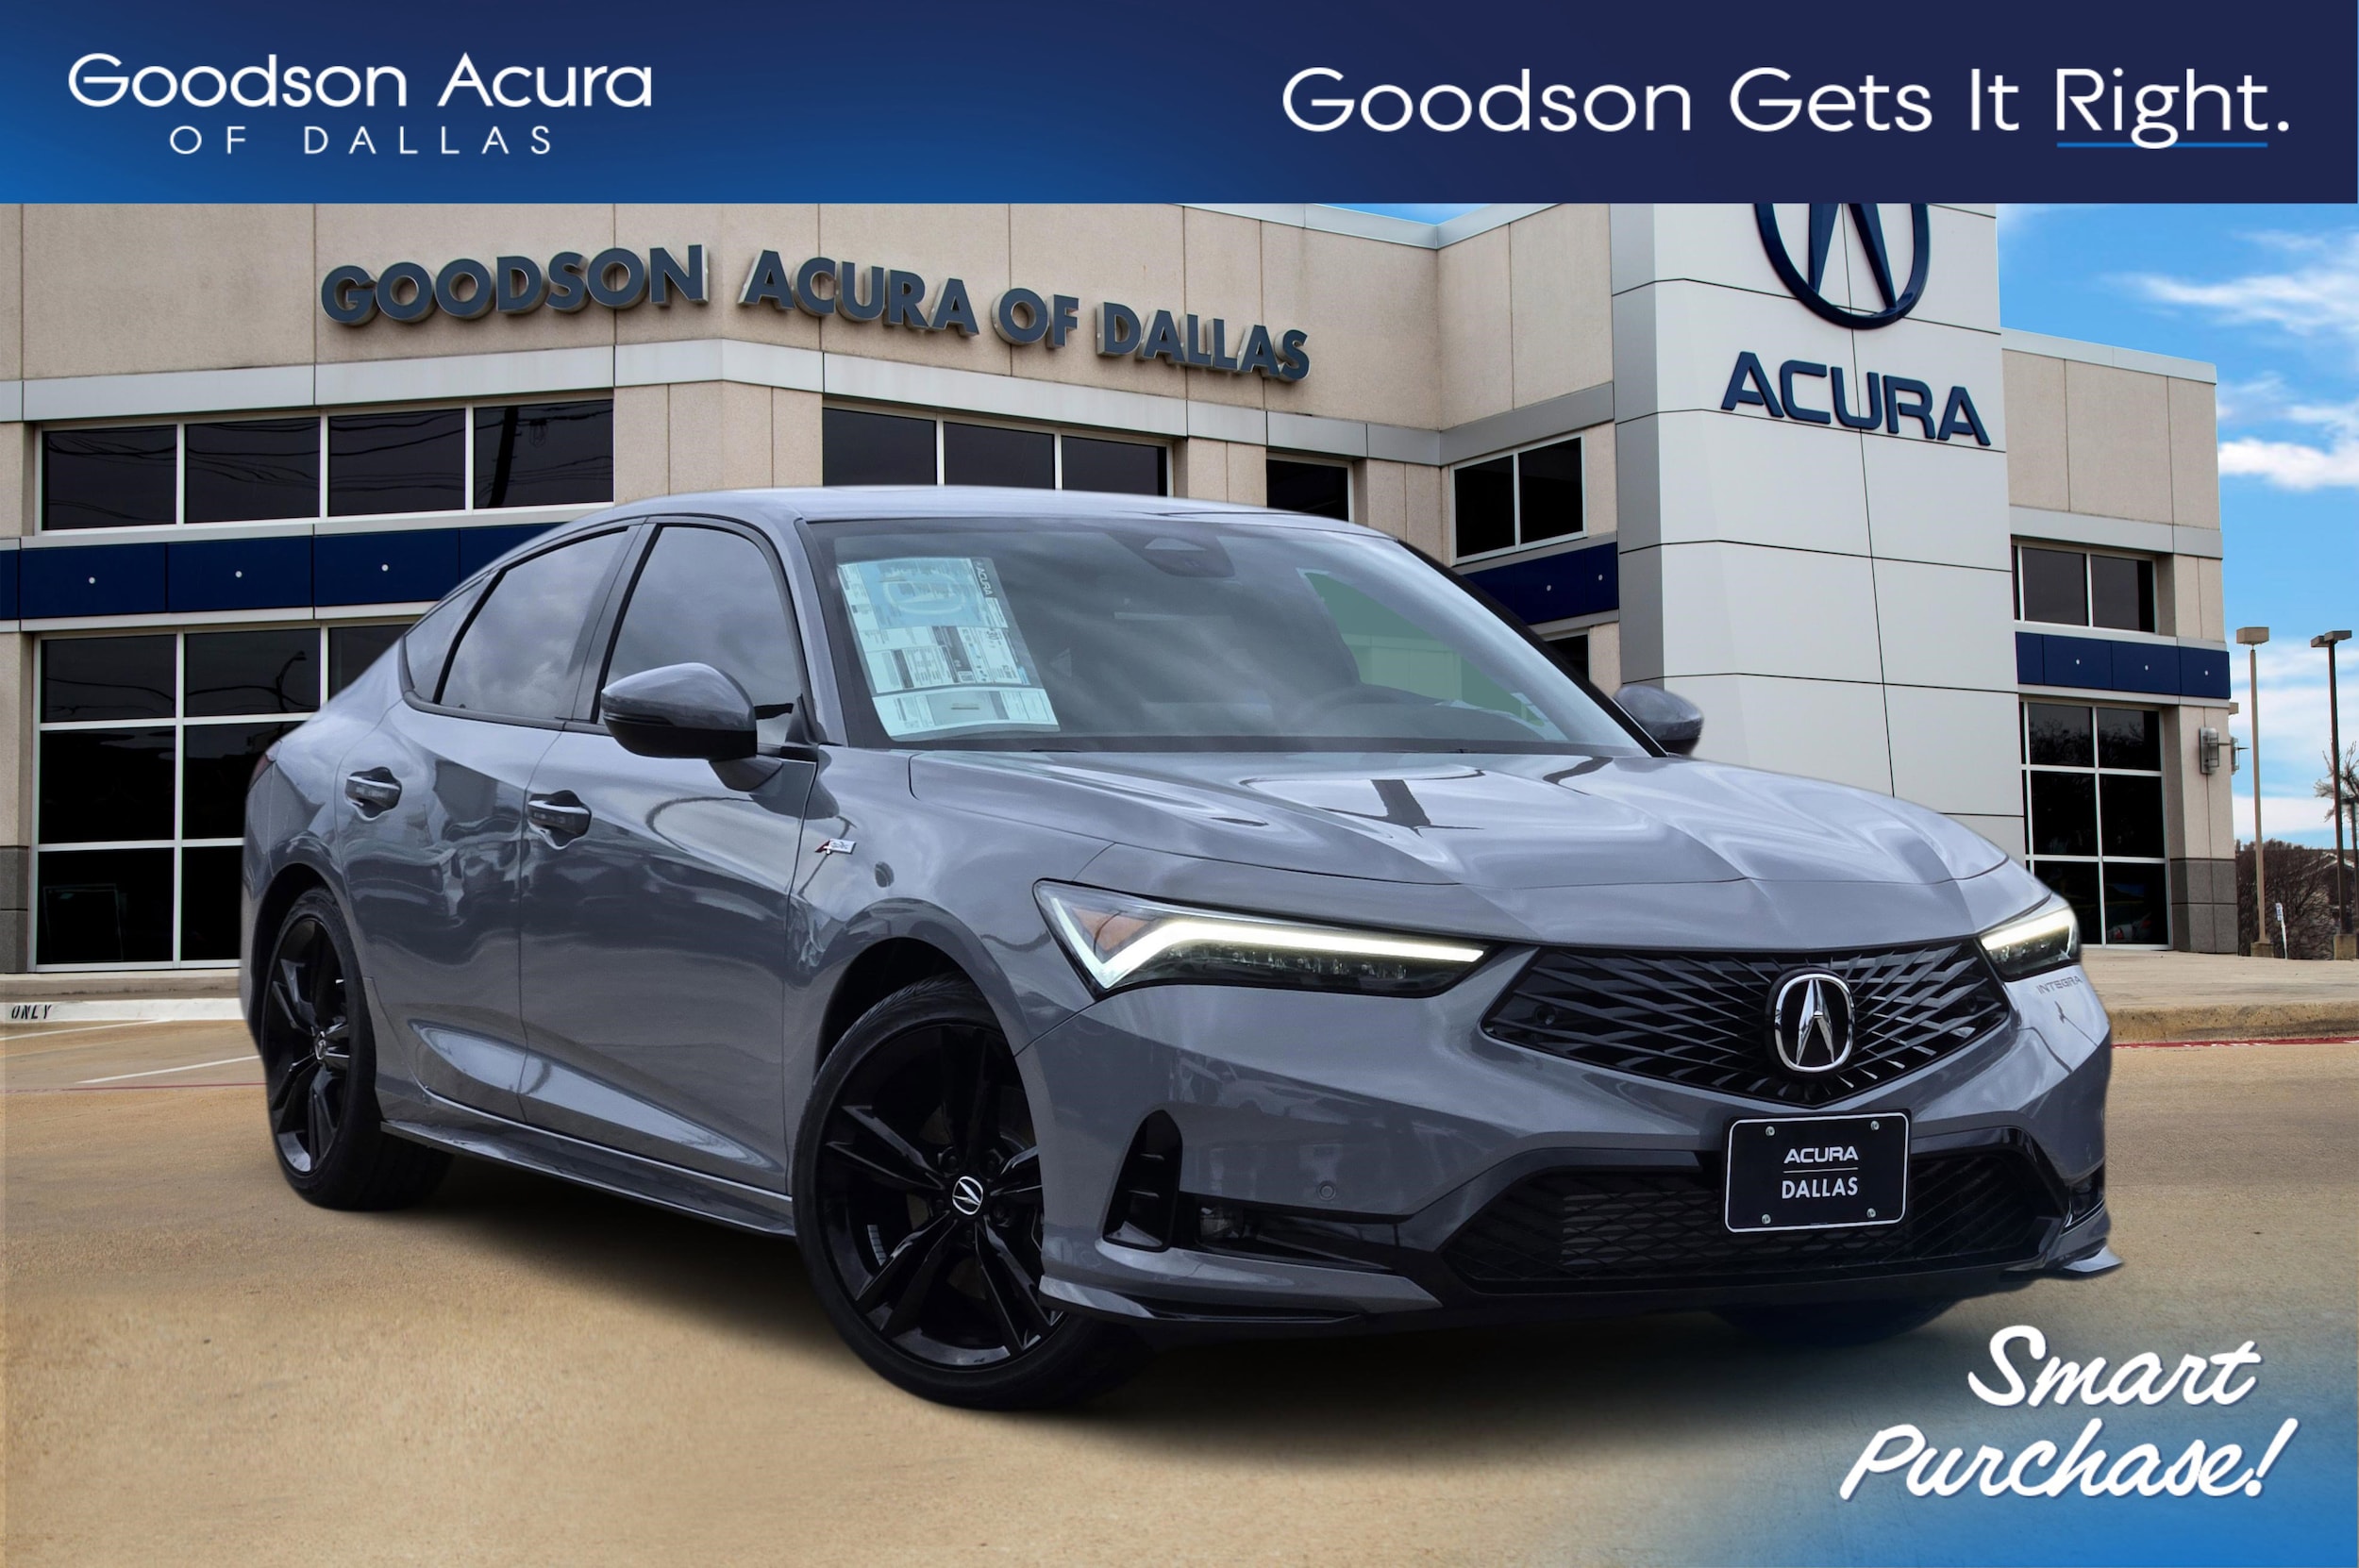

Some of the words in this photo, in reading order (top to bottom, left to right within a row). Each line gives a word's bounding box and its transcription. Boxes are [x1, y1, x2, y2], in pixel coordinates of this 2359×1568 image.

[321, 244, 709, 325] GOODSON
[738, 249, 979, 337] ACURA
[992, 287, 1079, 348] OF
[1096, 301, 1311, 382] DALLAS
[1720, 351, 1991, 446] ACURA
[2036, 976, 2083, 994] INTEGRA
[11, 1004, 52, 1020] ONLY
[1783, 1145, 1859, 1164] ACURA
[1782, 1176, 1859, 1200] DALLAS
